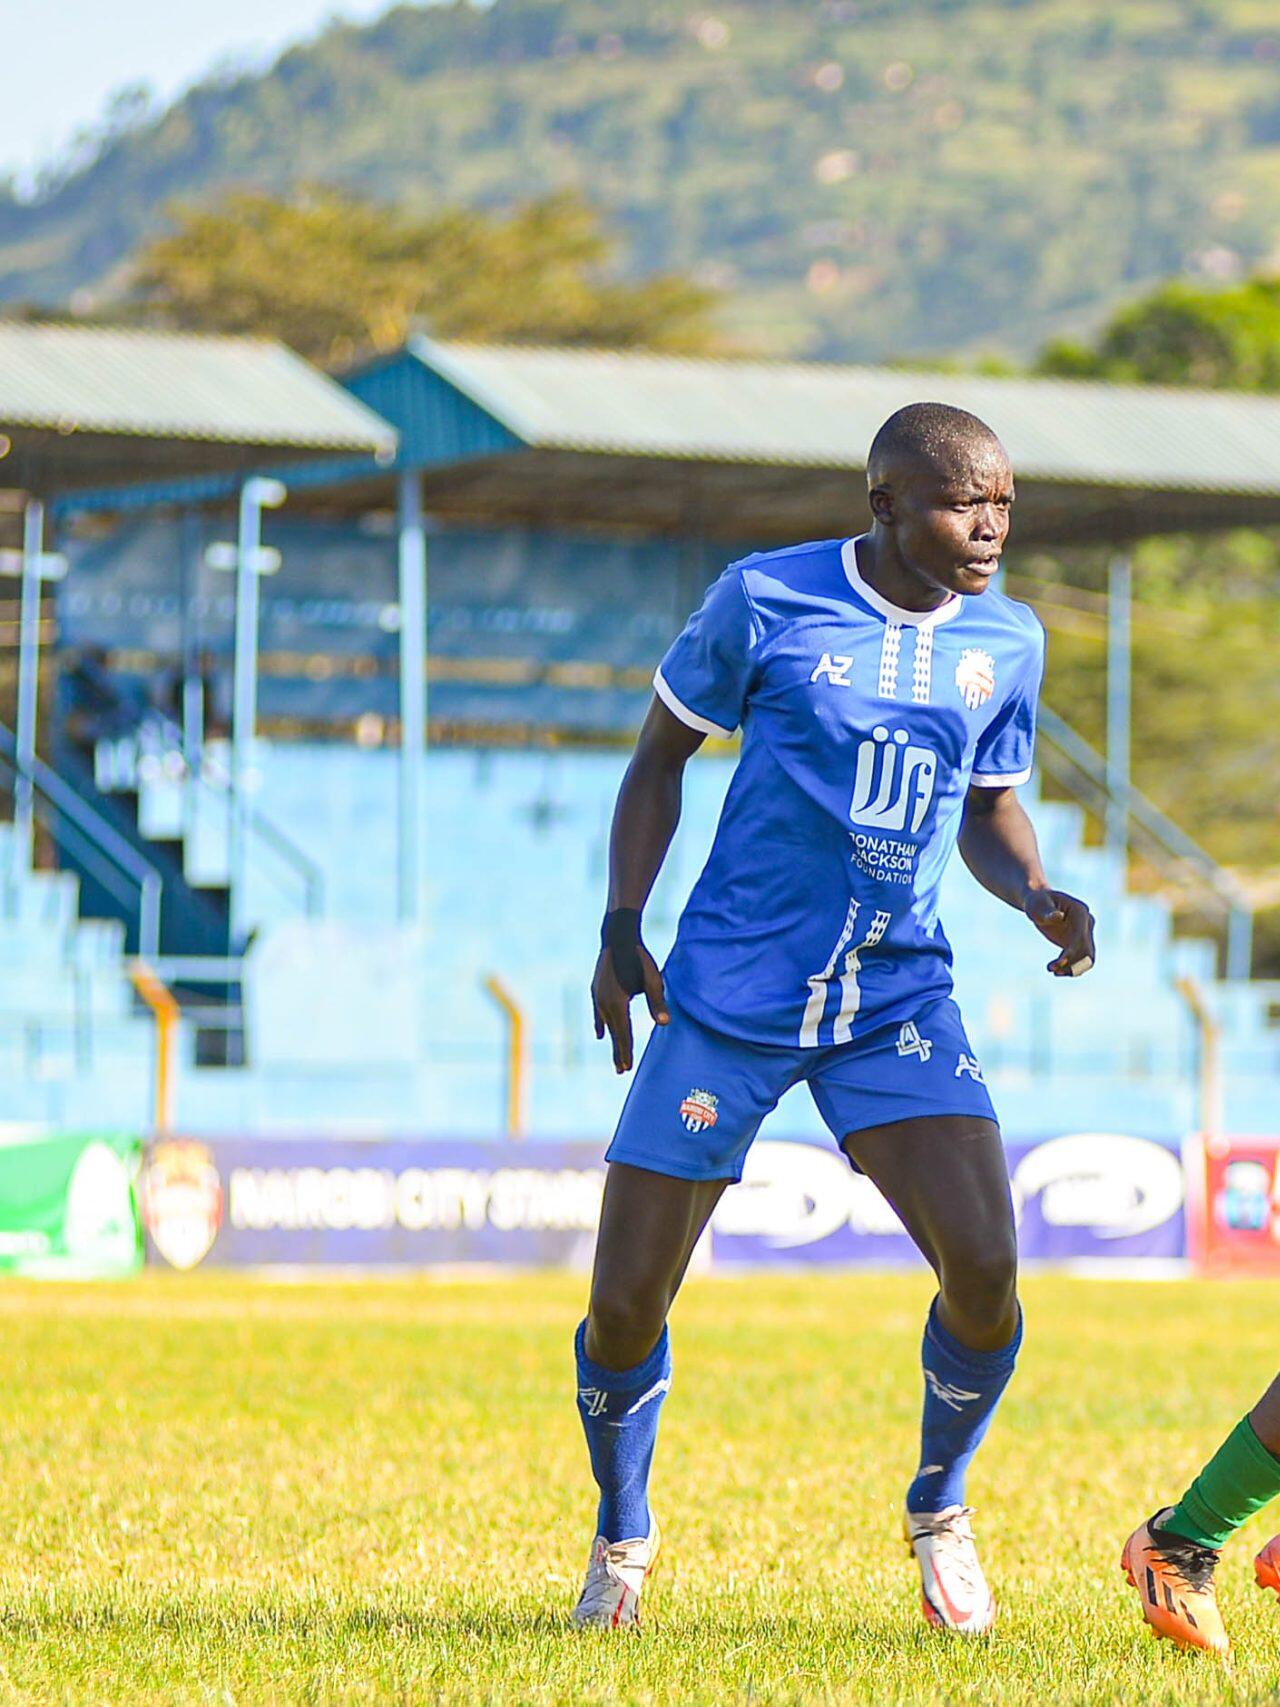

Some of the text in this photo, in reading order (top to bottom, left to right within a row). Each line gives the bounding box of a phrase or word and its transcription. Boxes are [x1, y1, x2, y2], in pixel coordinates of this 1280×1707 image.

[810, 652, 854, 687] AZ
[895, 1021, 933, 1063] 4
[397, 1167, 490, 1231] CITY
